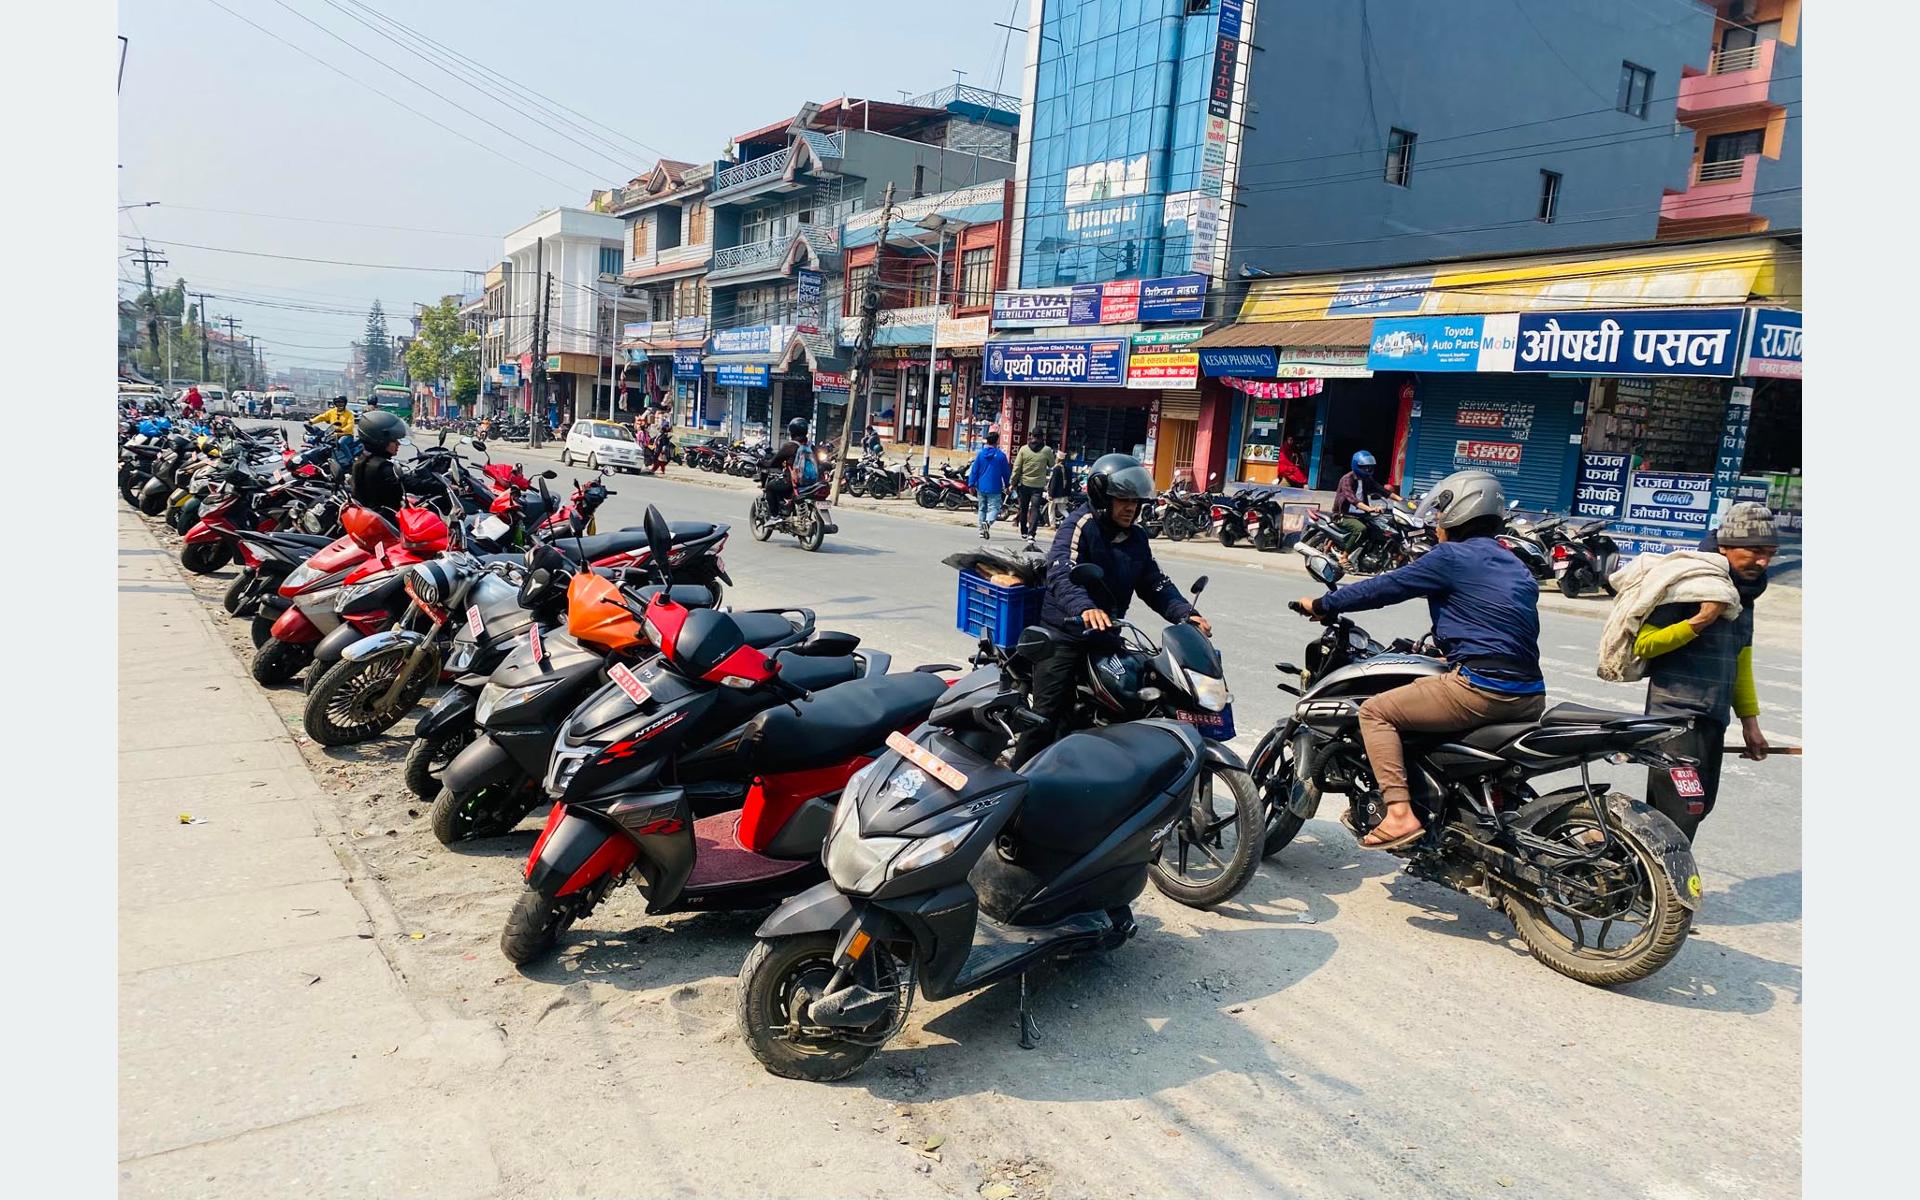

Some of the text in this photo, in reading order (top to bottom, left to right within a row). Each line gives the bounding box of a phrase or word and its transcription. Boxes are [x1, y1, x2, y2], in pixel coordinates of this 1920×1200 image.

[1215, 40, 1234, 99] ELITE
[1067, 200, 1138, 231] Restaurant
[1006, 293, 1068, 308] FEWA
[996, 309, 1068, 319] FERTILITY CENTRE
[1444, 327, 1474, 338] Toyota
[1432, 339, 1479, 350] Auto Parts
[1521, 318, 1731, 366] औषधी पसल
[1004, 354, 1033, 380] पृथ्वी
[1037, 353, 1088, 377] फार्मेसी
[1204, 354, 1229, 367] KESAR
[1229, 353, 1272, 366] PHARMACY
[1458, 411, 1499, 425] SERVO
[1470, 444, 1519, 460] SERVO
[1584, 454, 1625, 468] राजन
[1585, 467, 1619, 482] फर्मा
[1636, 477, 1711, 491] राजन फर्मा
[1577, 486, 1622, 502] औषधि
[1631, 507, 1707, 522] औषधी पसल
[635, 712, 677, 738] NTORQ
